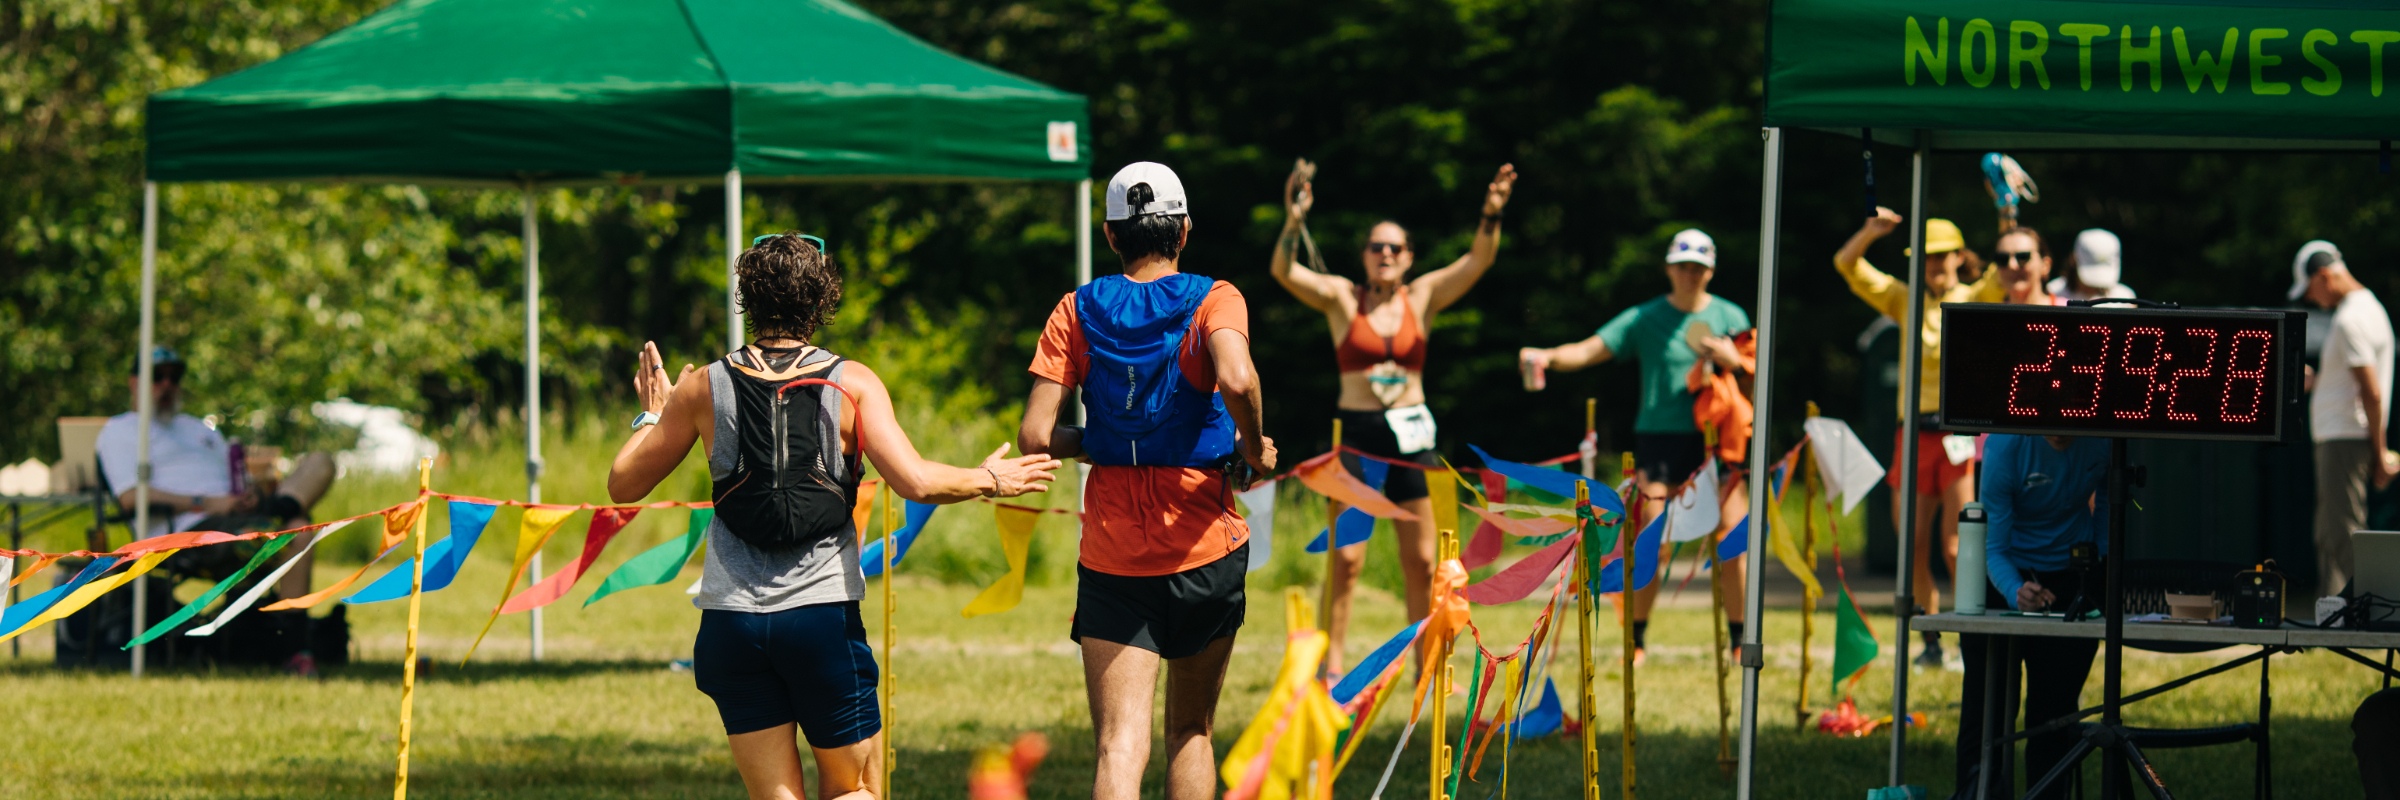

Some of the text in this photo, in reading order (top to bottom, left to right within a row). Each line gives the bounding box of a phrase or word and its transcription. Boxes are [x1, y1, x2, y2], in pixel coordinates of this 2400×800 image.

[1905, 16, 2400, 97] NORTHWEST
[1126, 365, 1136, 410] SALOMON
[2008, 323, 2272, 422] 2:39:28
